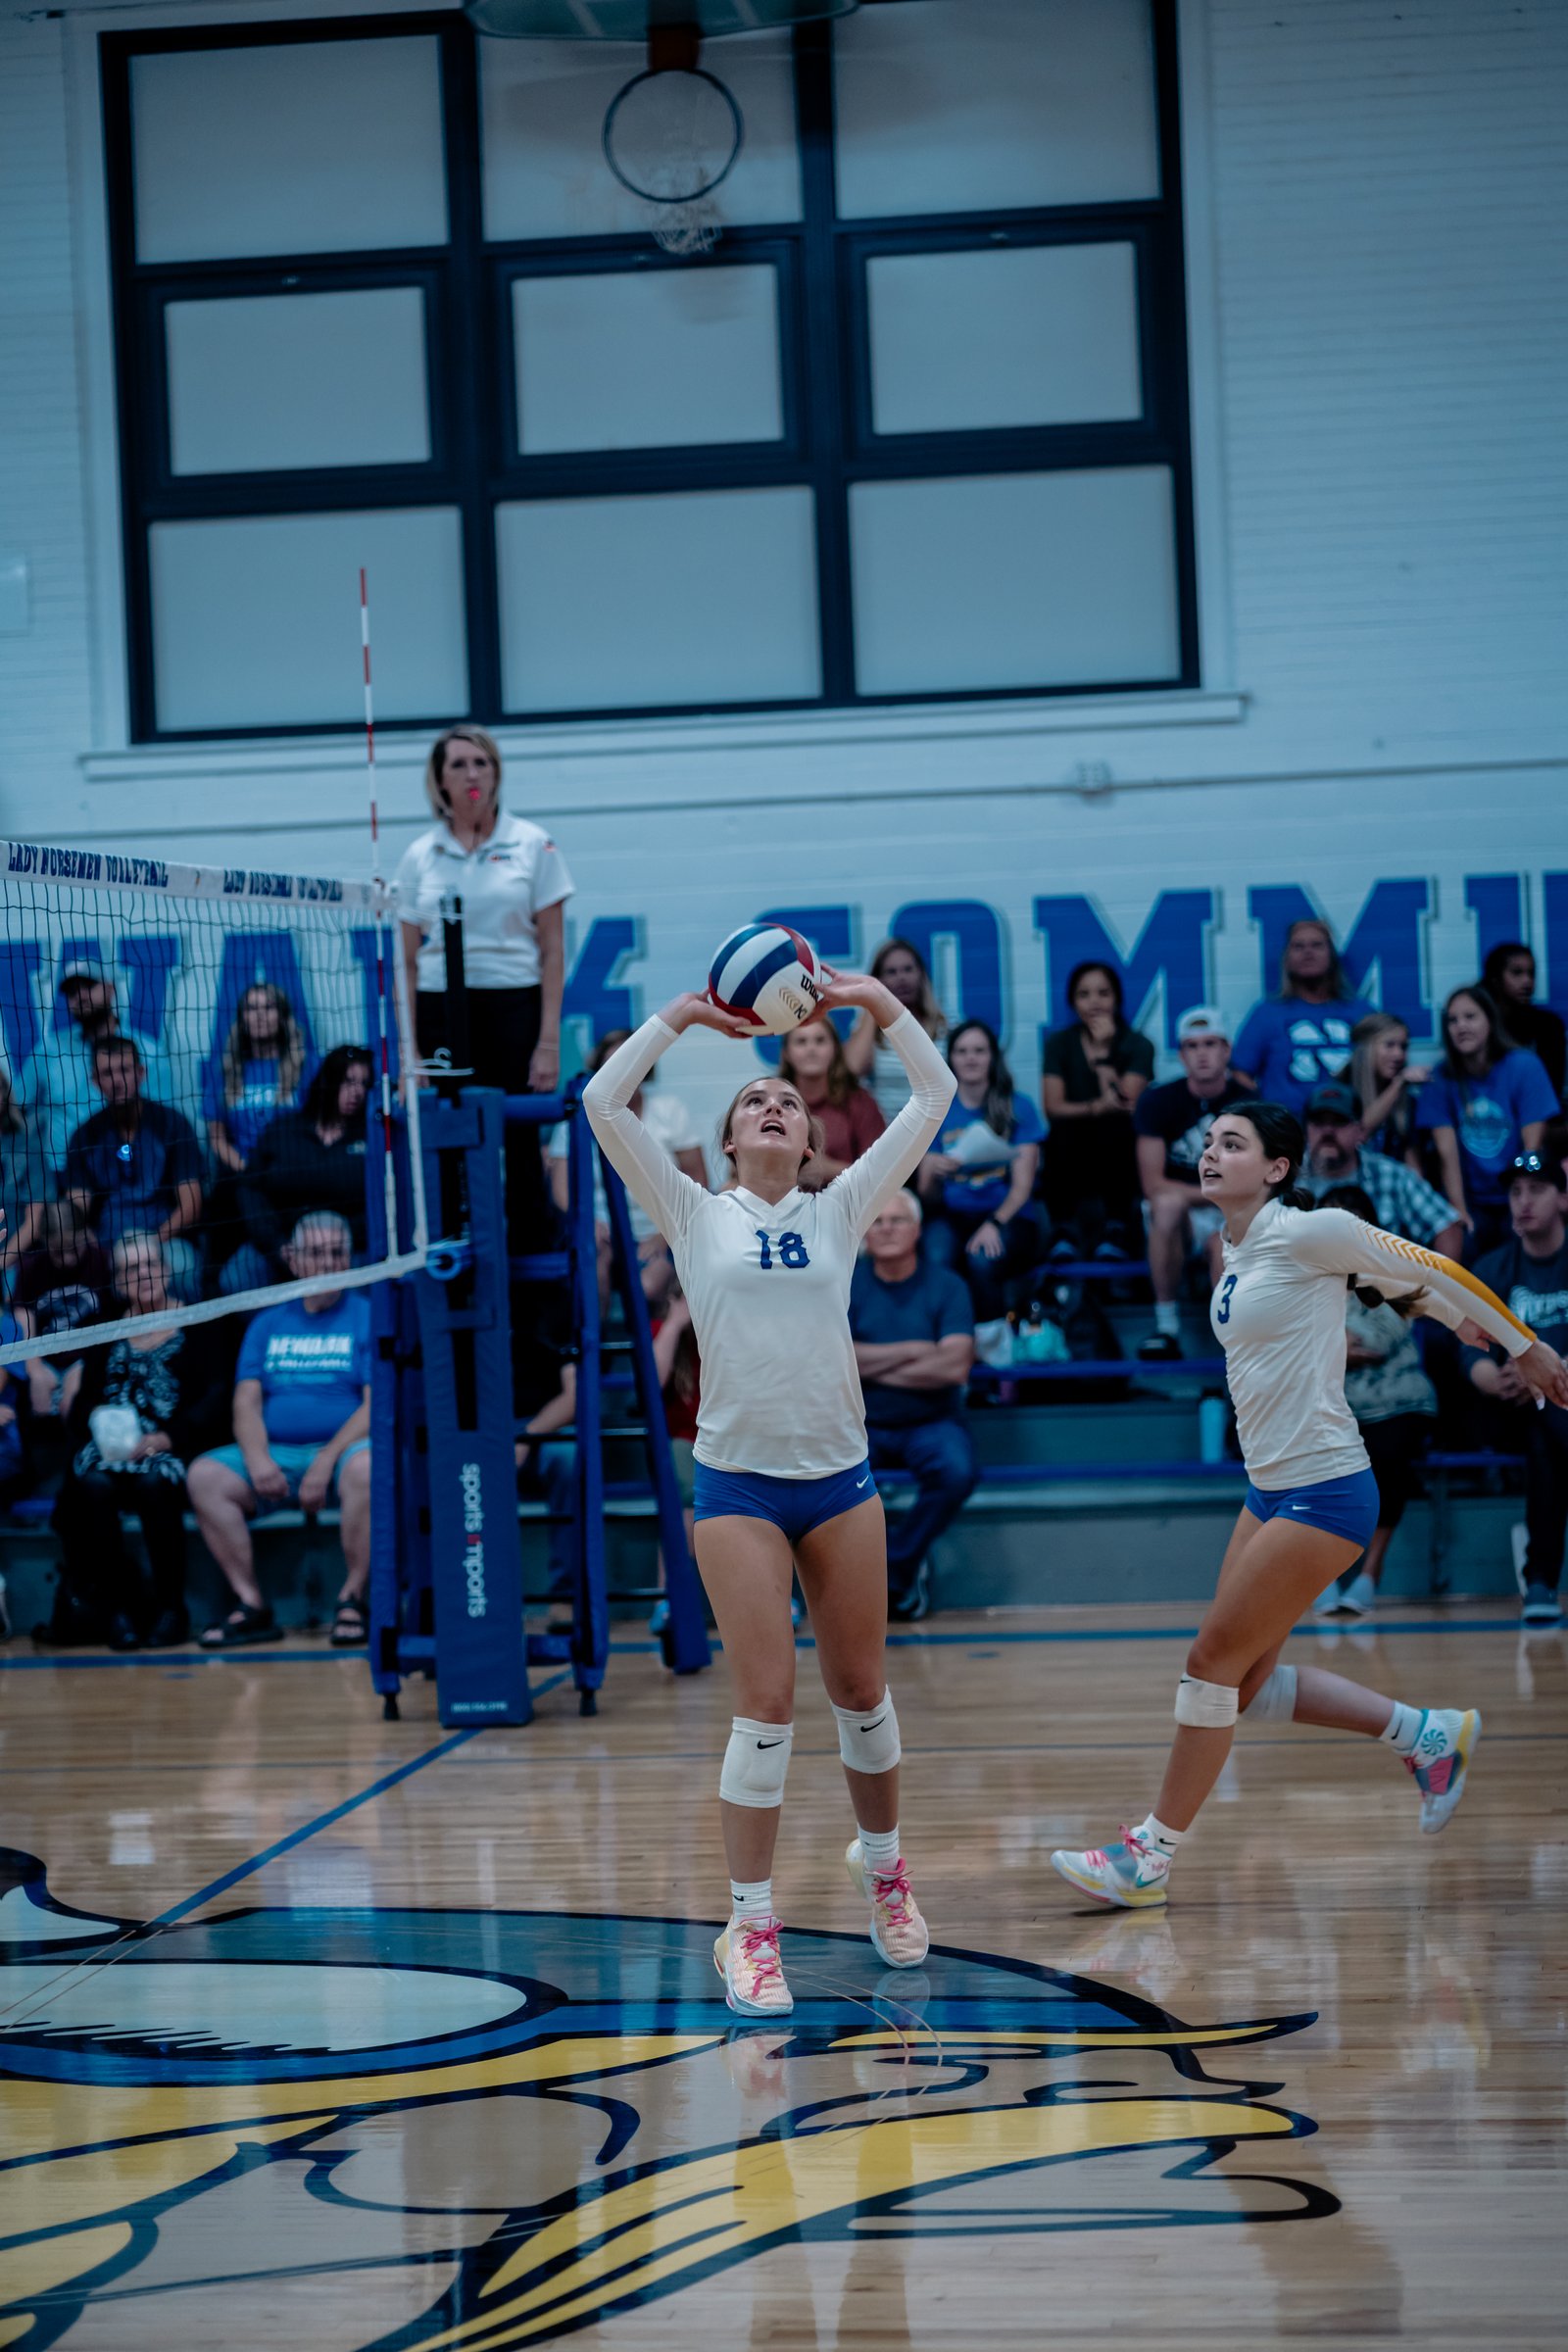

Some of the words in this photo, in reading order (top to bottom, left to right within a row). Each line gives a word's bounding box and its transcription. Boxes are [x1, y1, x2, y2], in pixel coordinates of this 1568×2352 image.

[8, 842, 38, 874] LADY
[41, 847, 102, 881] NORSEMEN
[756, 1229, 810, 1270] 18
[1217, 1274, 1239, 1325] 3
[459, 1463, 484, 1533] sports
